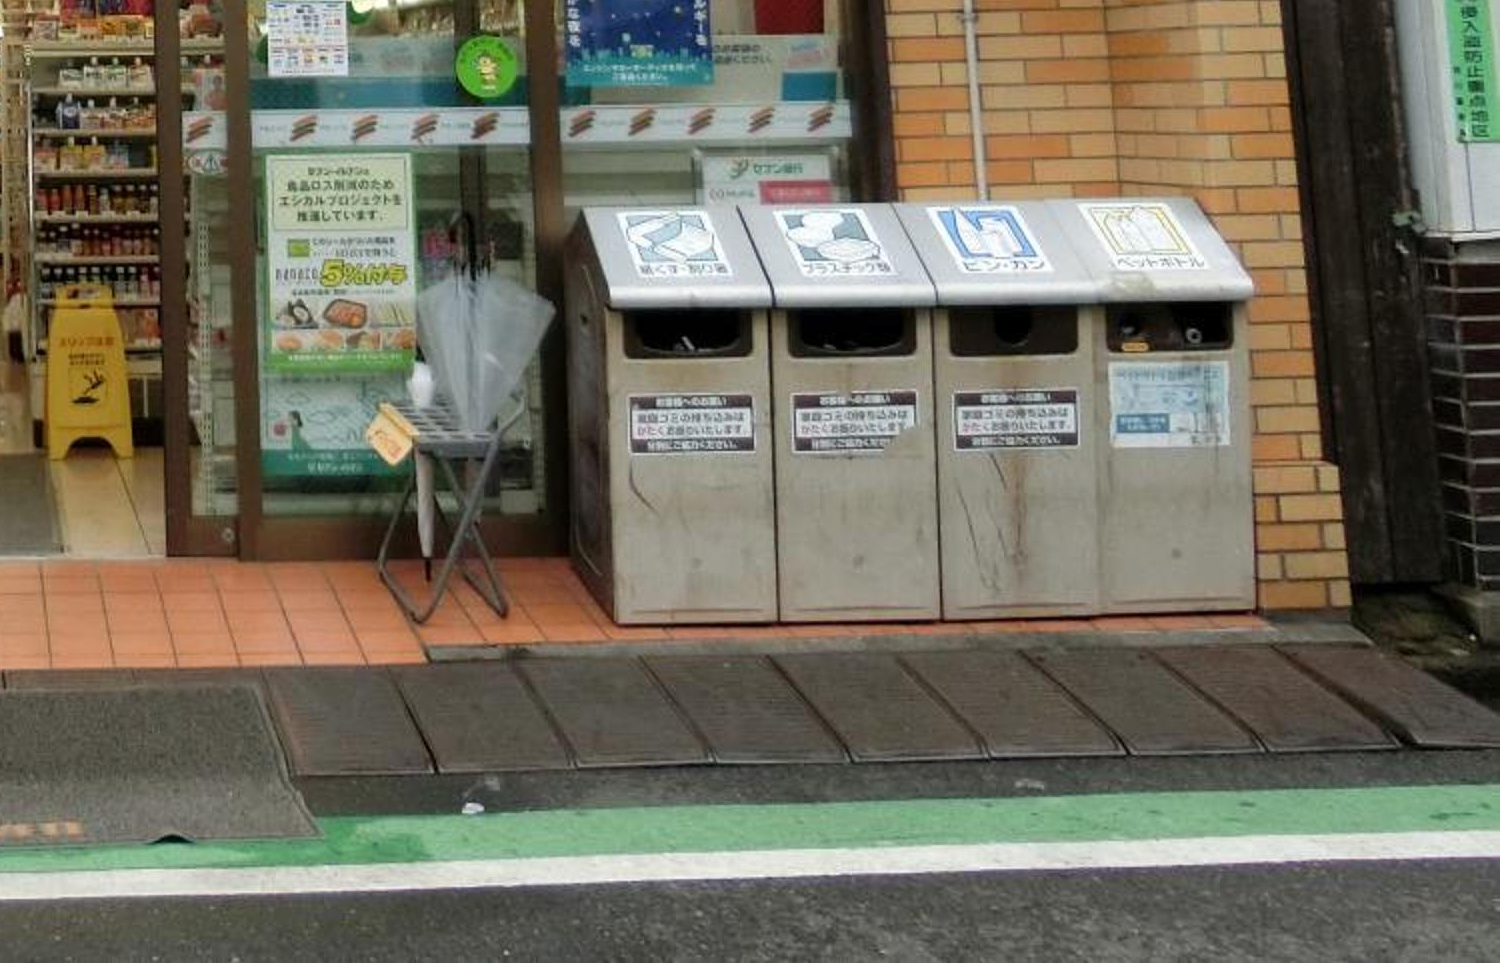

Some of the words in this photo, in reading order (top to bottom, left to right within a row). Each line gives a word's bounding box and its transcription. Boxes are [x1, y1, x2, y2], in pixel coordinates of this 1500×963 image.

[287, 179, 395, 192] 食品ロス削減のため
[279, 194, 402, 206] エシカルプロジェクトを
[802, 262, 892, 275] プラスチック類
[962, 259, 1046, 272] ビン・カン
[1116, 256, 1206, 269] ペットボトル
